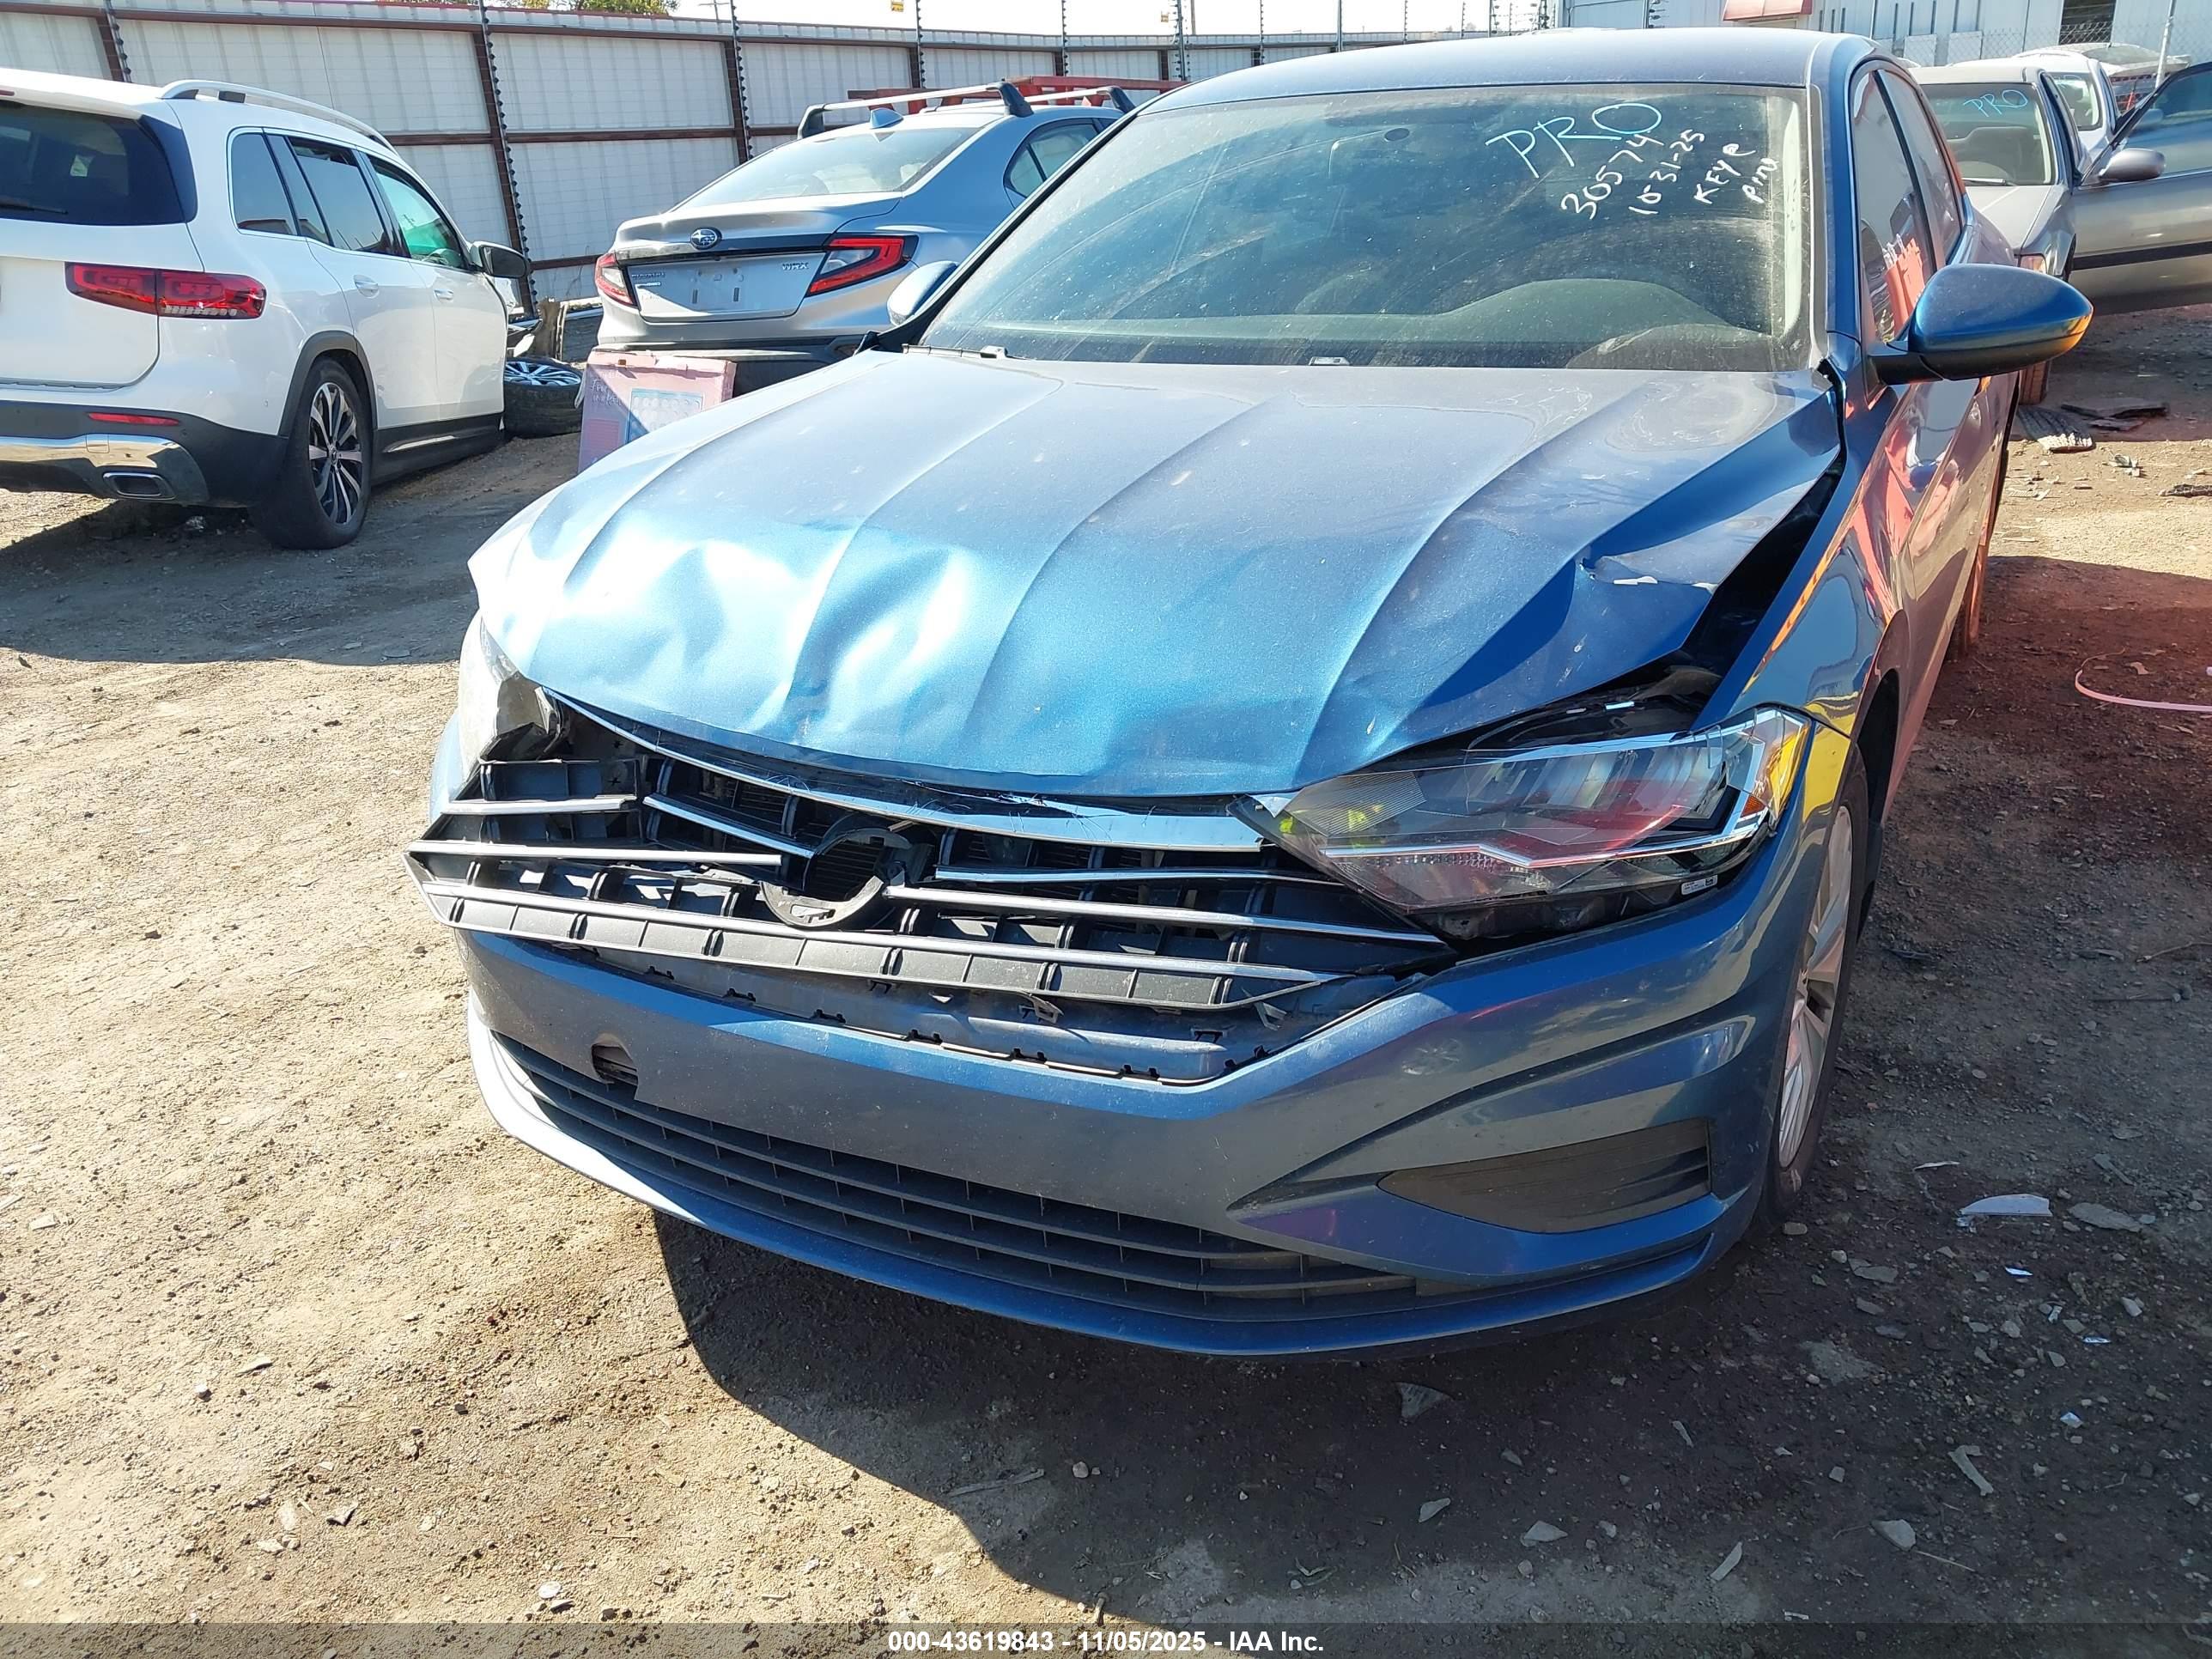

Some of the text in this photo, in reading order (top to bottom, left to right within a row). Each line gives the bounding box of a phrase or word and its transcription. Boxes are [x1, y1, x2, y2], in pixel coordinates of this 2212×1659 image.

[1963, 89, 2028, 117] PRO
[1486, 104, 1662, 178] PRO
[1694, 160, 1741, 204] KEY
[782, 262, 809, 271] WRX
